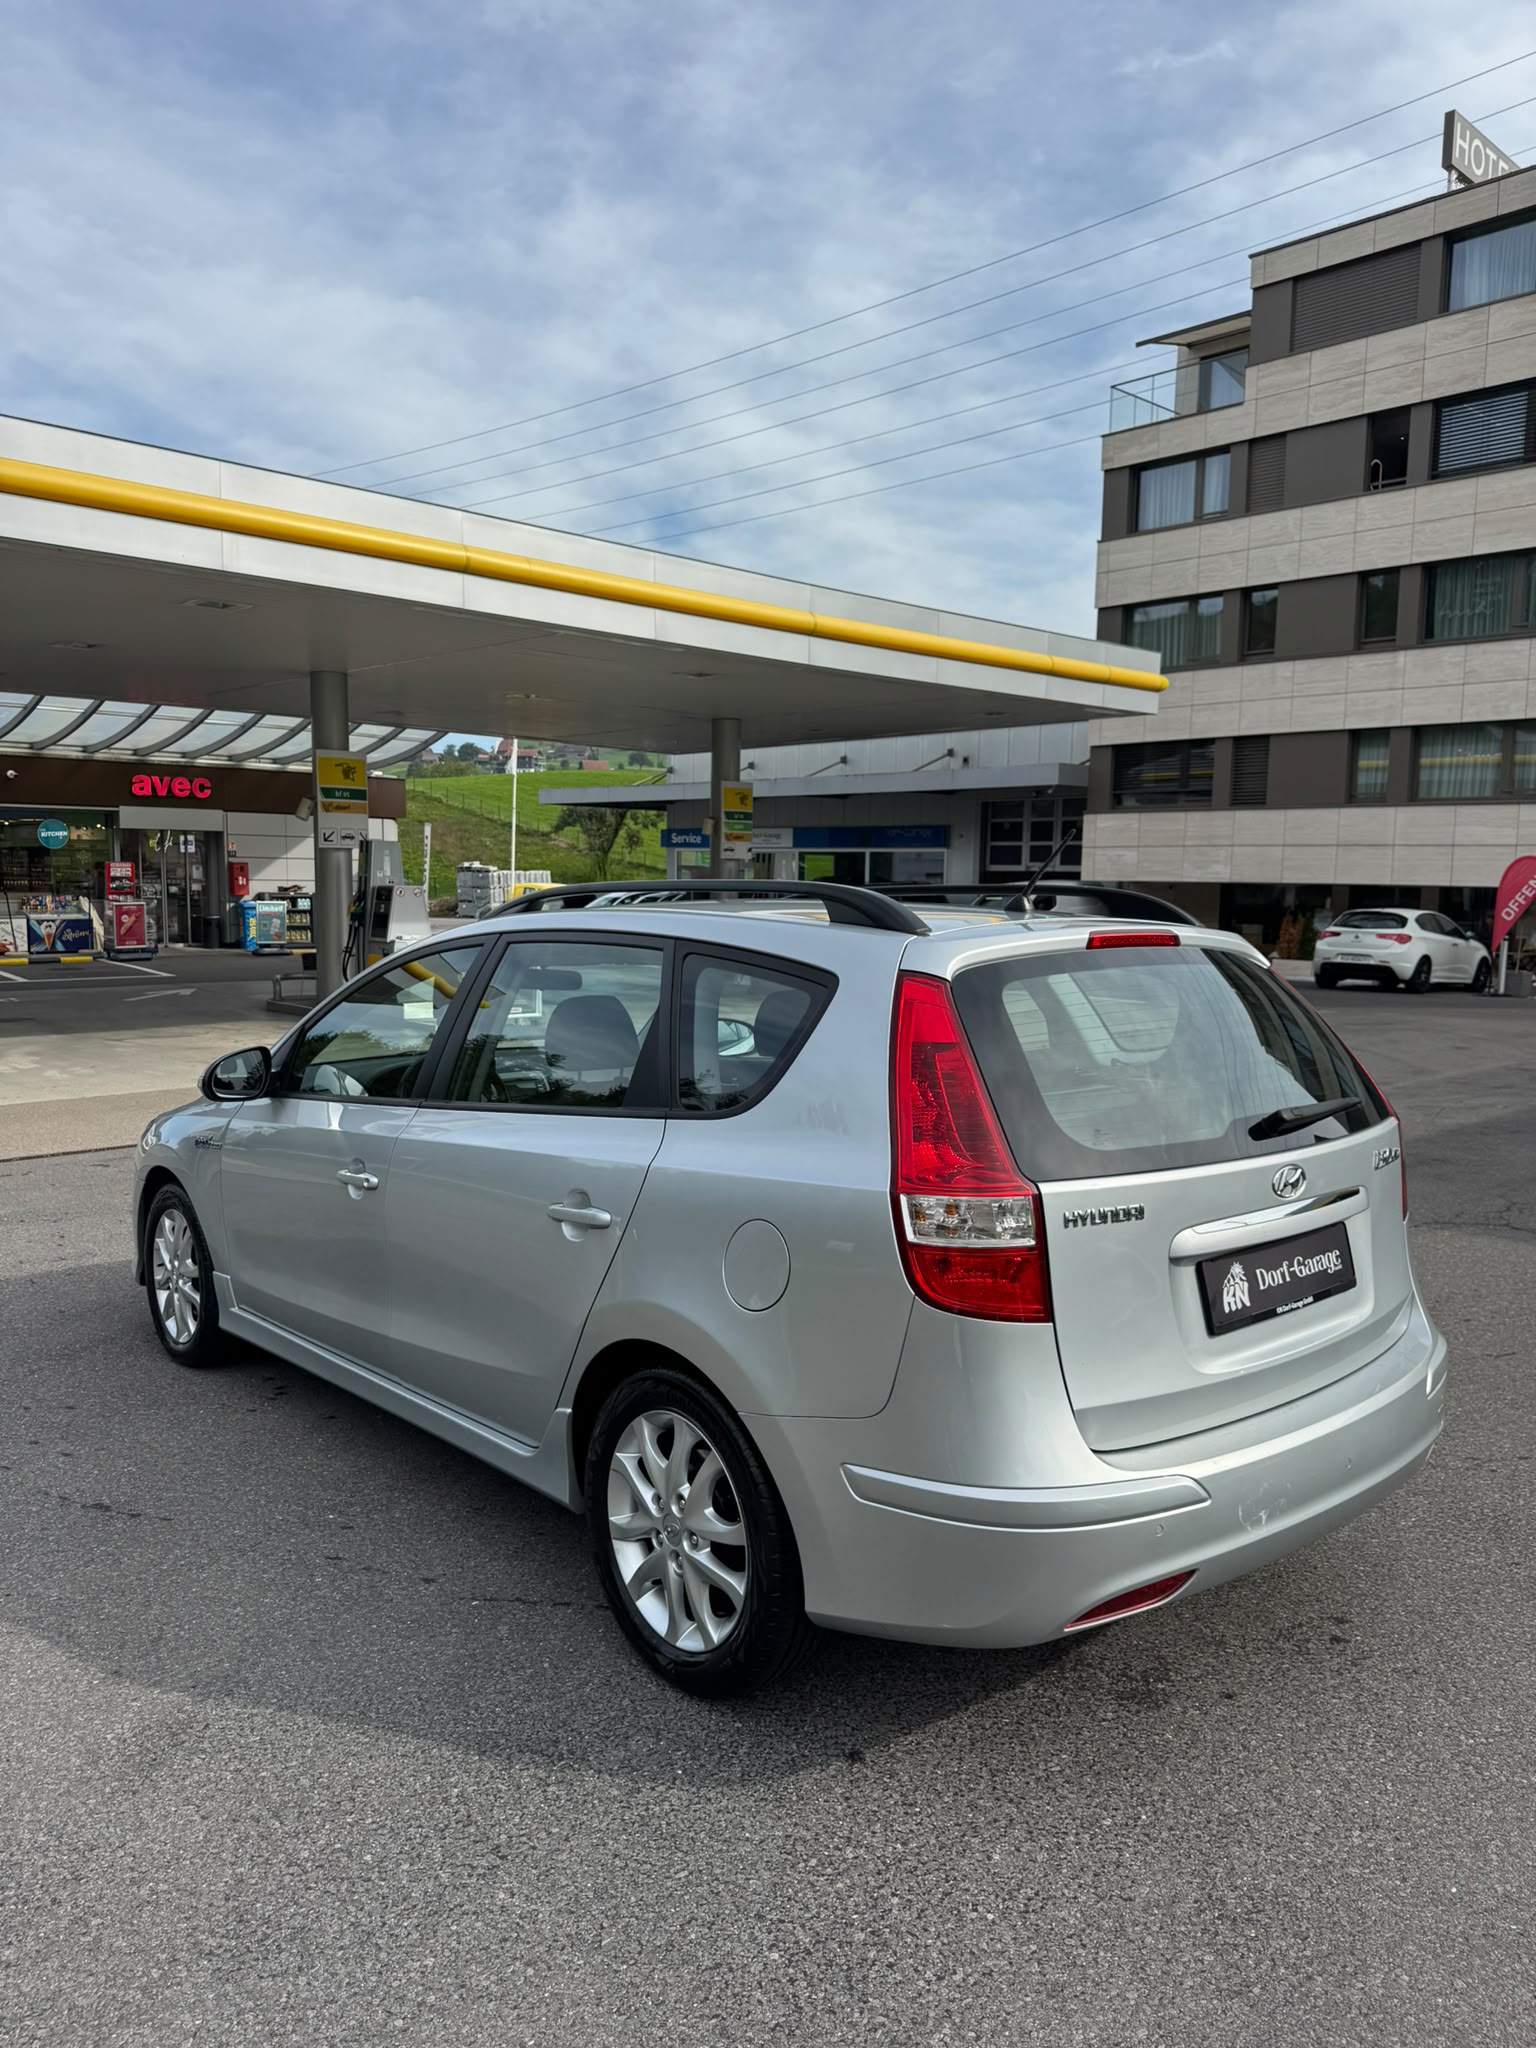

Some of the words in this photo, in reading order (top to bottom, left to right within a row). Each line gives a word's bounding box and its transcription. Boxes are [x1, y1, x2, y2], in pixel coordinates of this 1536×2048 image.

[131, 774, 212, 799] avec
[671, 832, 702, 844] Service
[1063, 1203, 1145, 1229] HYUNDAI
[1255, 1249, 1342, 1290] Dorf-Garage
